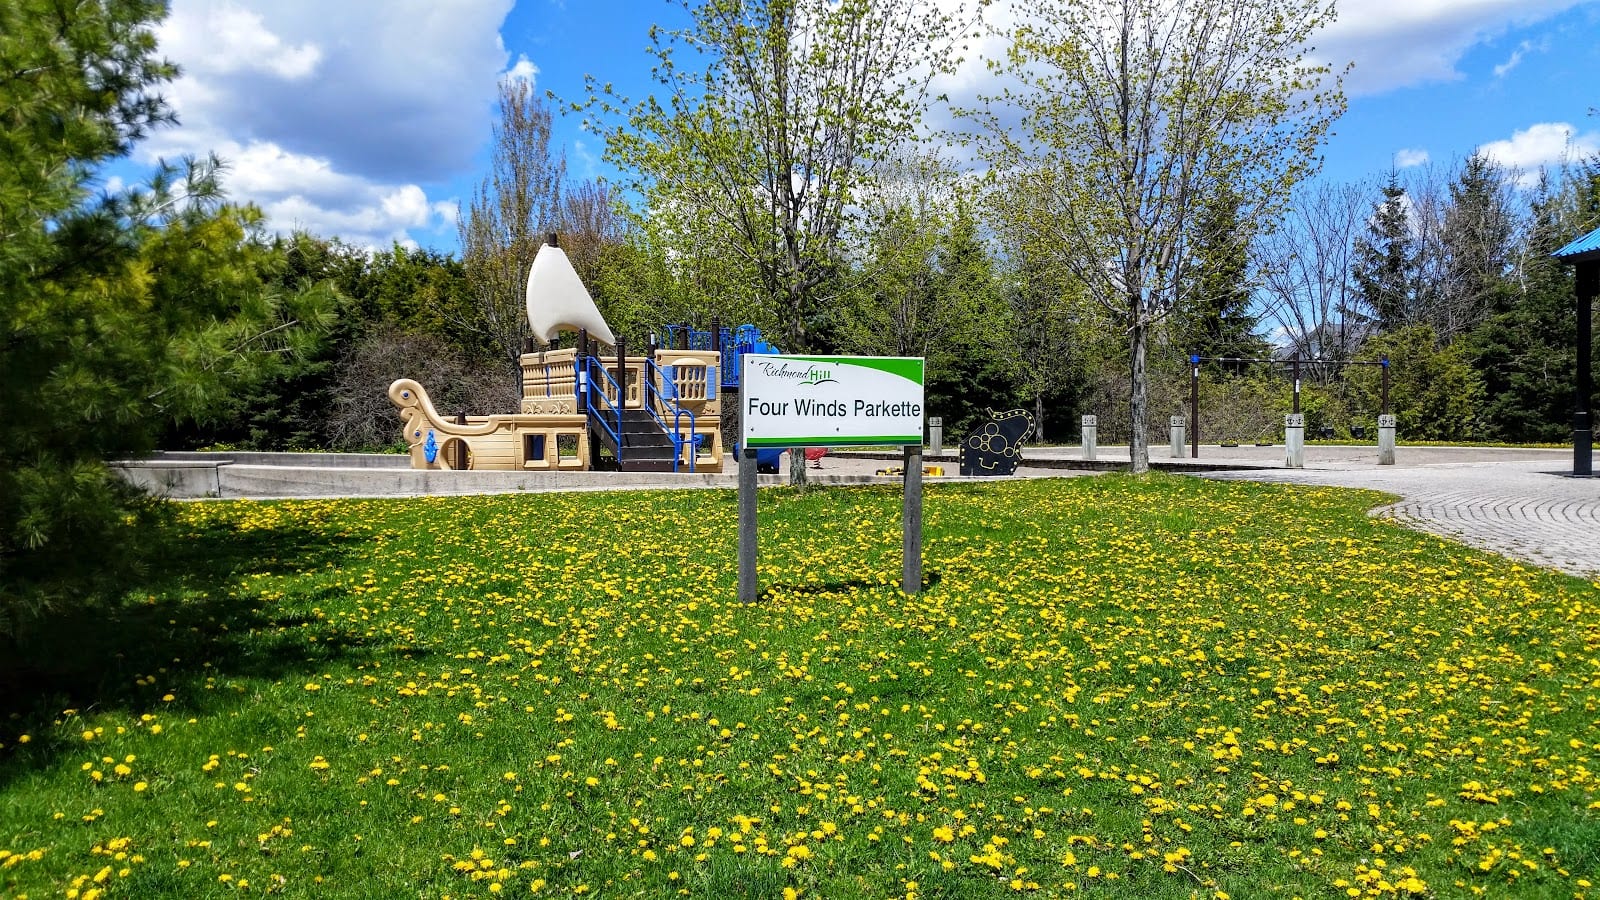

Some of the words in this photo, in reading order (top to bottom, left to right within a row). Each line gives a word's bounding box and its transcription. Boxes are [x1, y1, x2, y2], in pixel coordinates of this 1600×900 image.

[758, 361, 816, 379] Richmond
[810, 369, 831, 381] Hill
[748, 397, 789, 416] Four
[793, 398, 847, 417] Winds
[853, 399, 921, 417] Parkette
